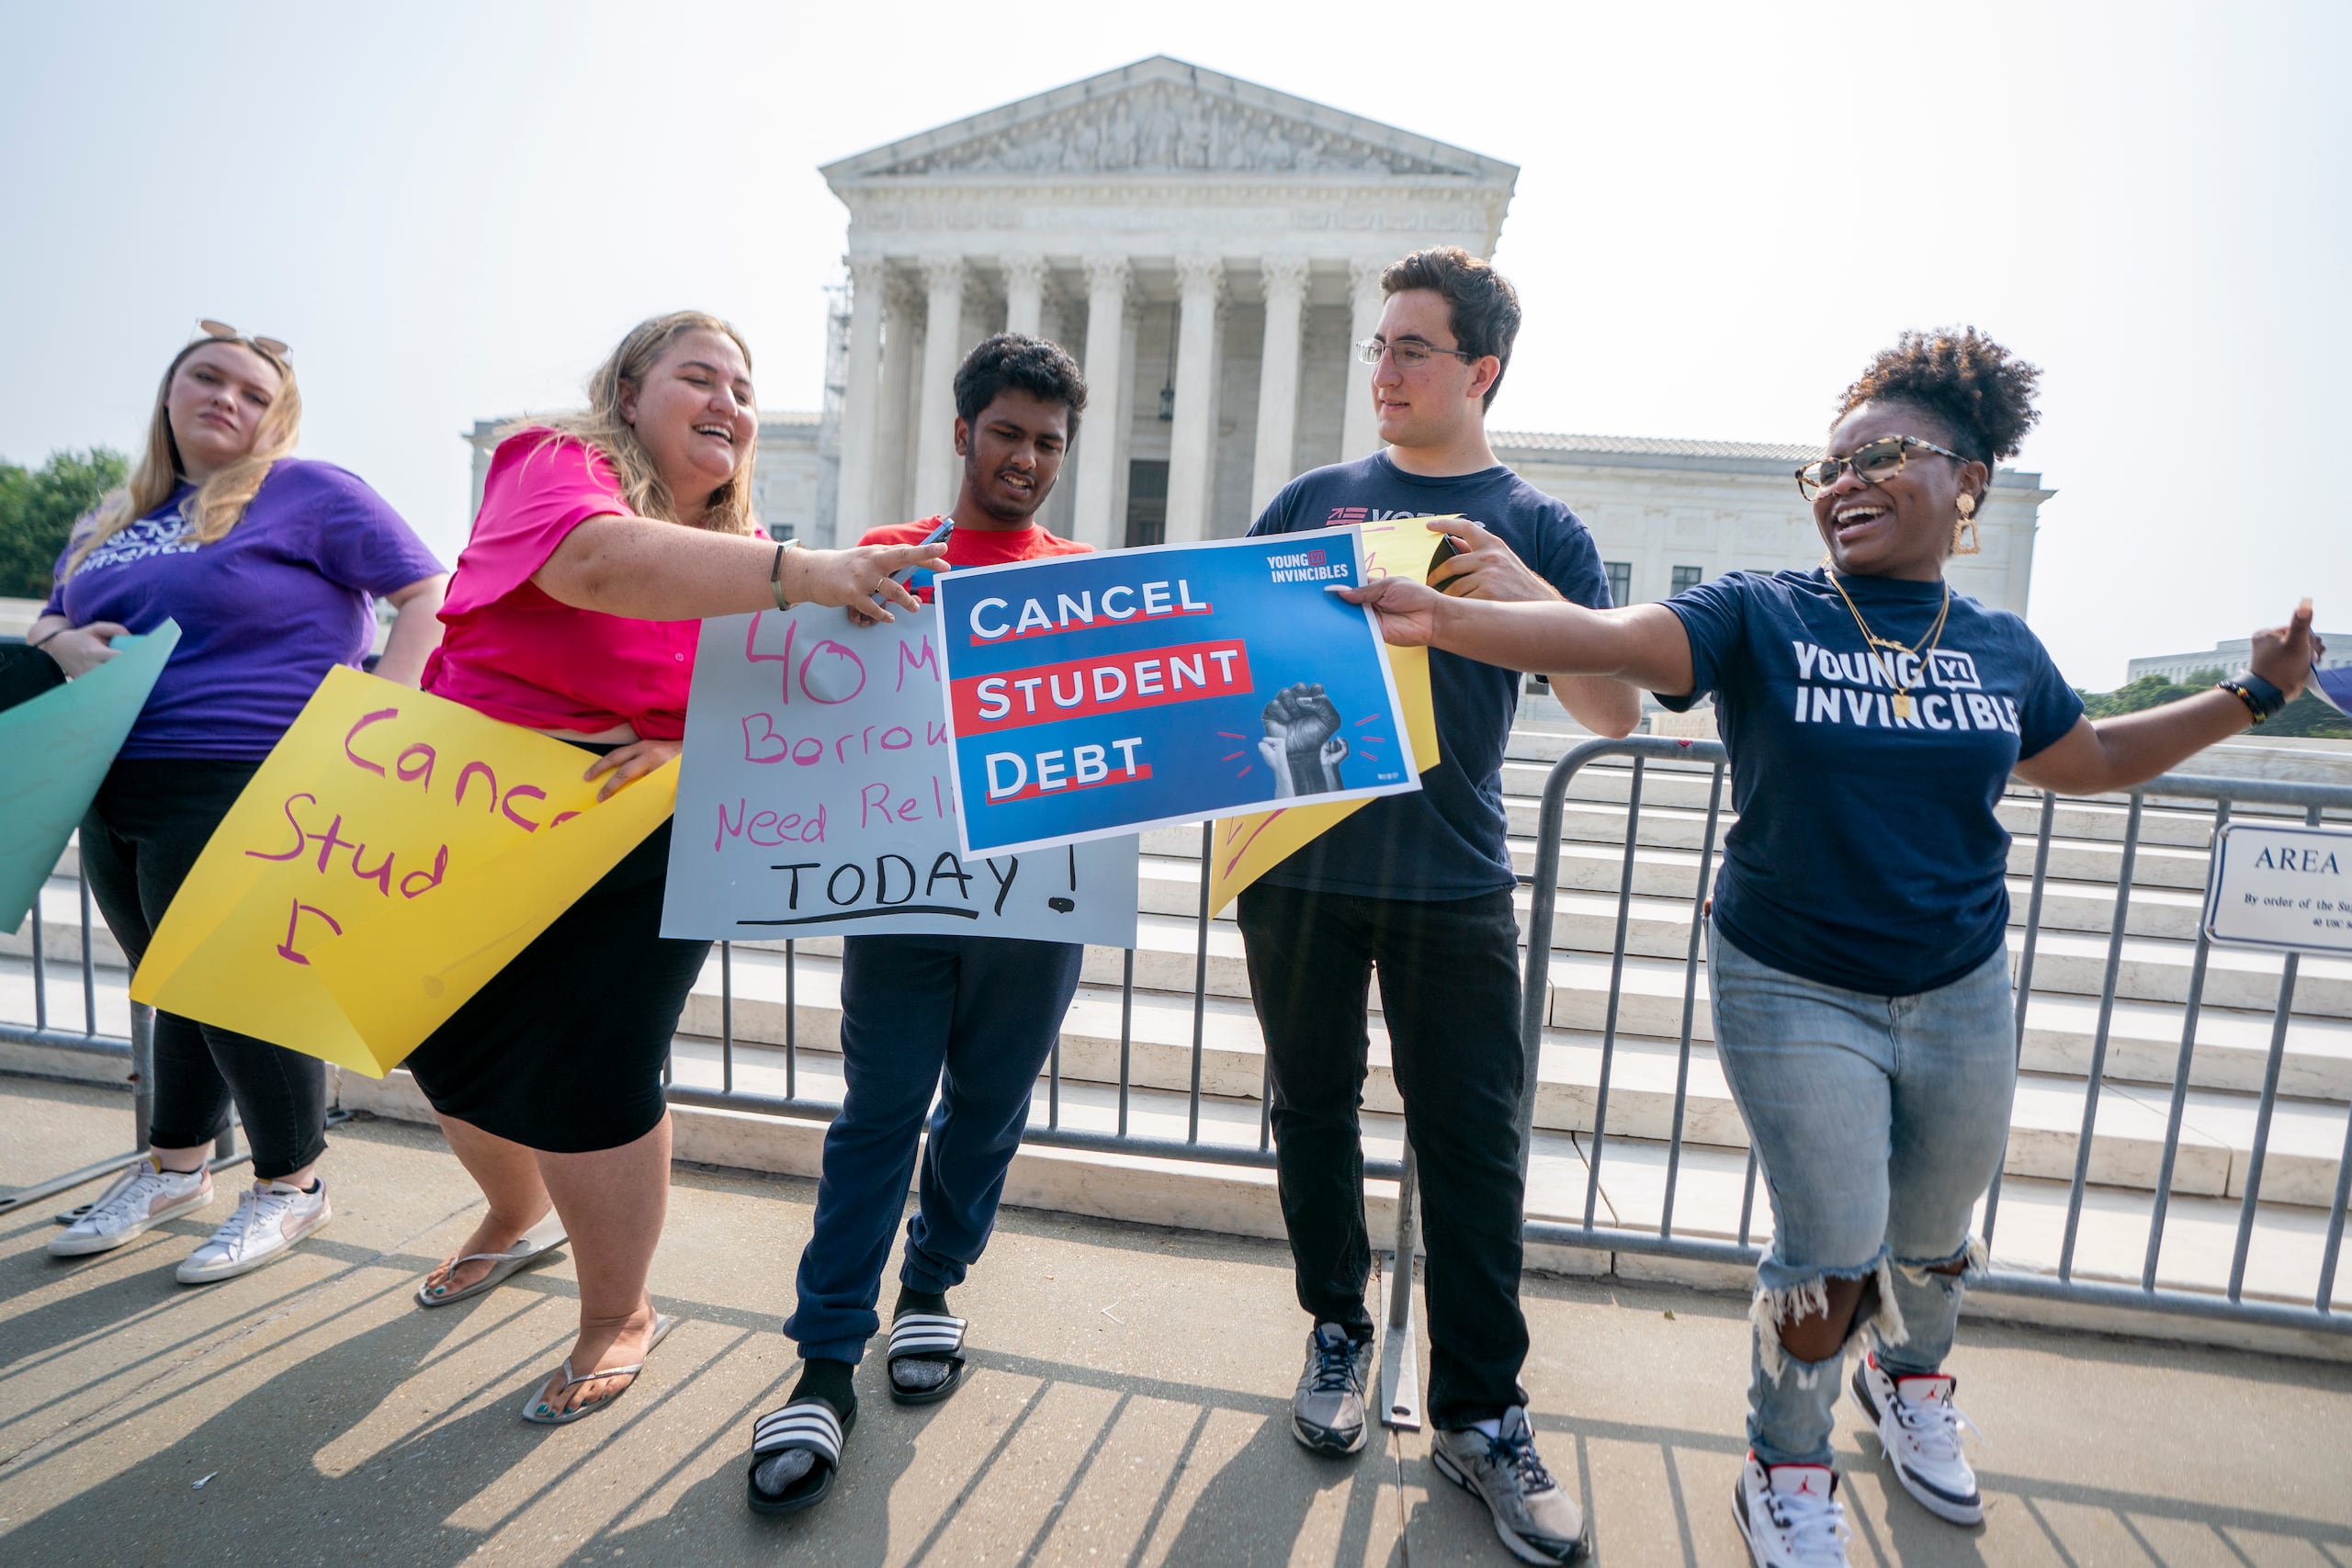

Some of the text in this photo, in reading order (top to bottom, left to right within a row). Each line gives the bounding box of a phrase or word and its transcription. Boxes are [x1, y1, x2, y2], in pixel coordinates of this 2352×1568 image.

[1266, 553, 1309, 570] YOUNG
[1271, 563, 1349, 583] INVINCIBLES
[969, 579, 1207, 639] CANCEL
[745, 610, 866, 705] 40
[976, 649, 1238, 721] STUDENT
[1792, 640, 1928, 689] YOUNG
[985, 737, 1143, 800] DEBT
[244, 792, 448, 899] Stud
[715, 797, 827, 852] Need
[2254, 845, 2340, 875] AREA
[2245, 892, 2352, 914] By order of the Su
